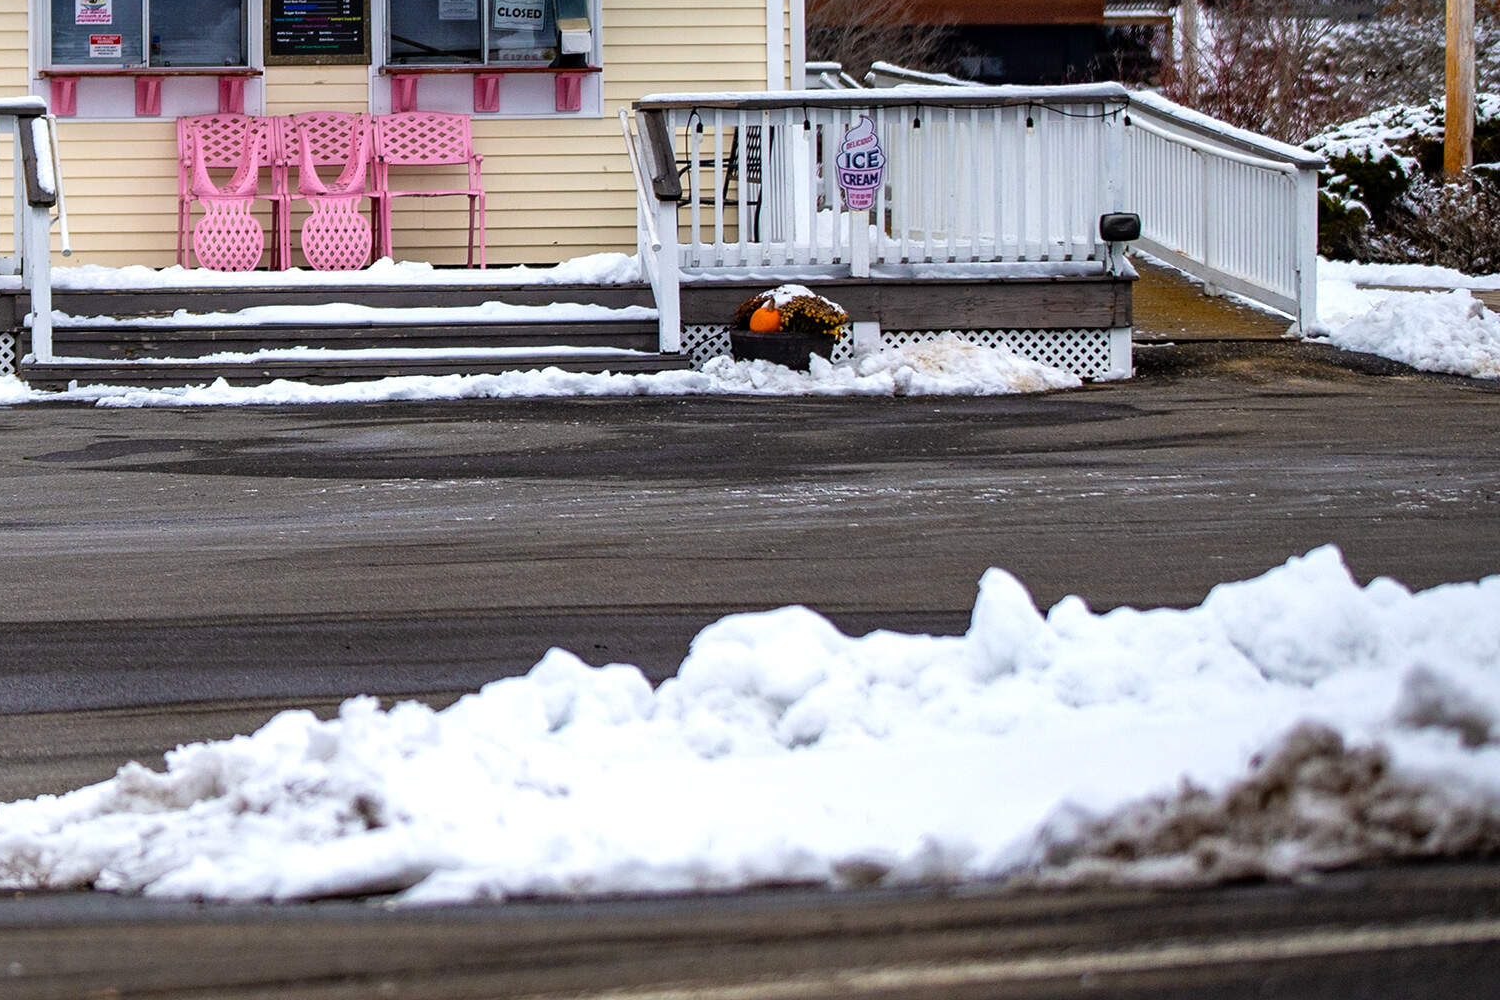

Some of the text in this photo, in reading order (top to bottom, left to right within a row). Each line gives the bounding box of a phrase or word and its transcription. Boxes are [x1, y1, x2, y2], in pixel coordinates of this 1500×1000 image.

[497, 7, 542, 19] CLOSED
[845, 150, 879, 168] ICE
[843, 173, 878, 186] CREAM
